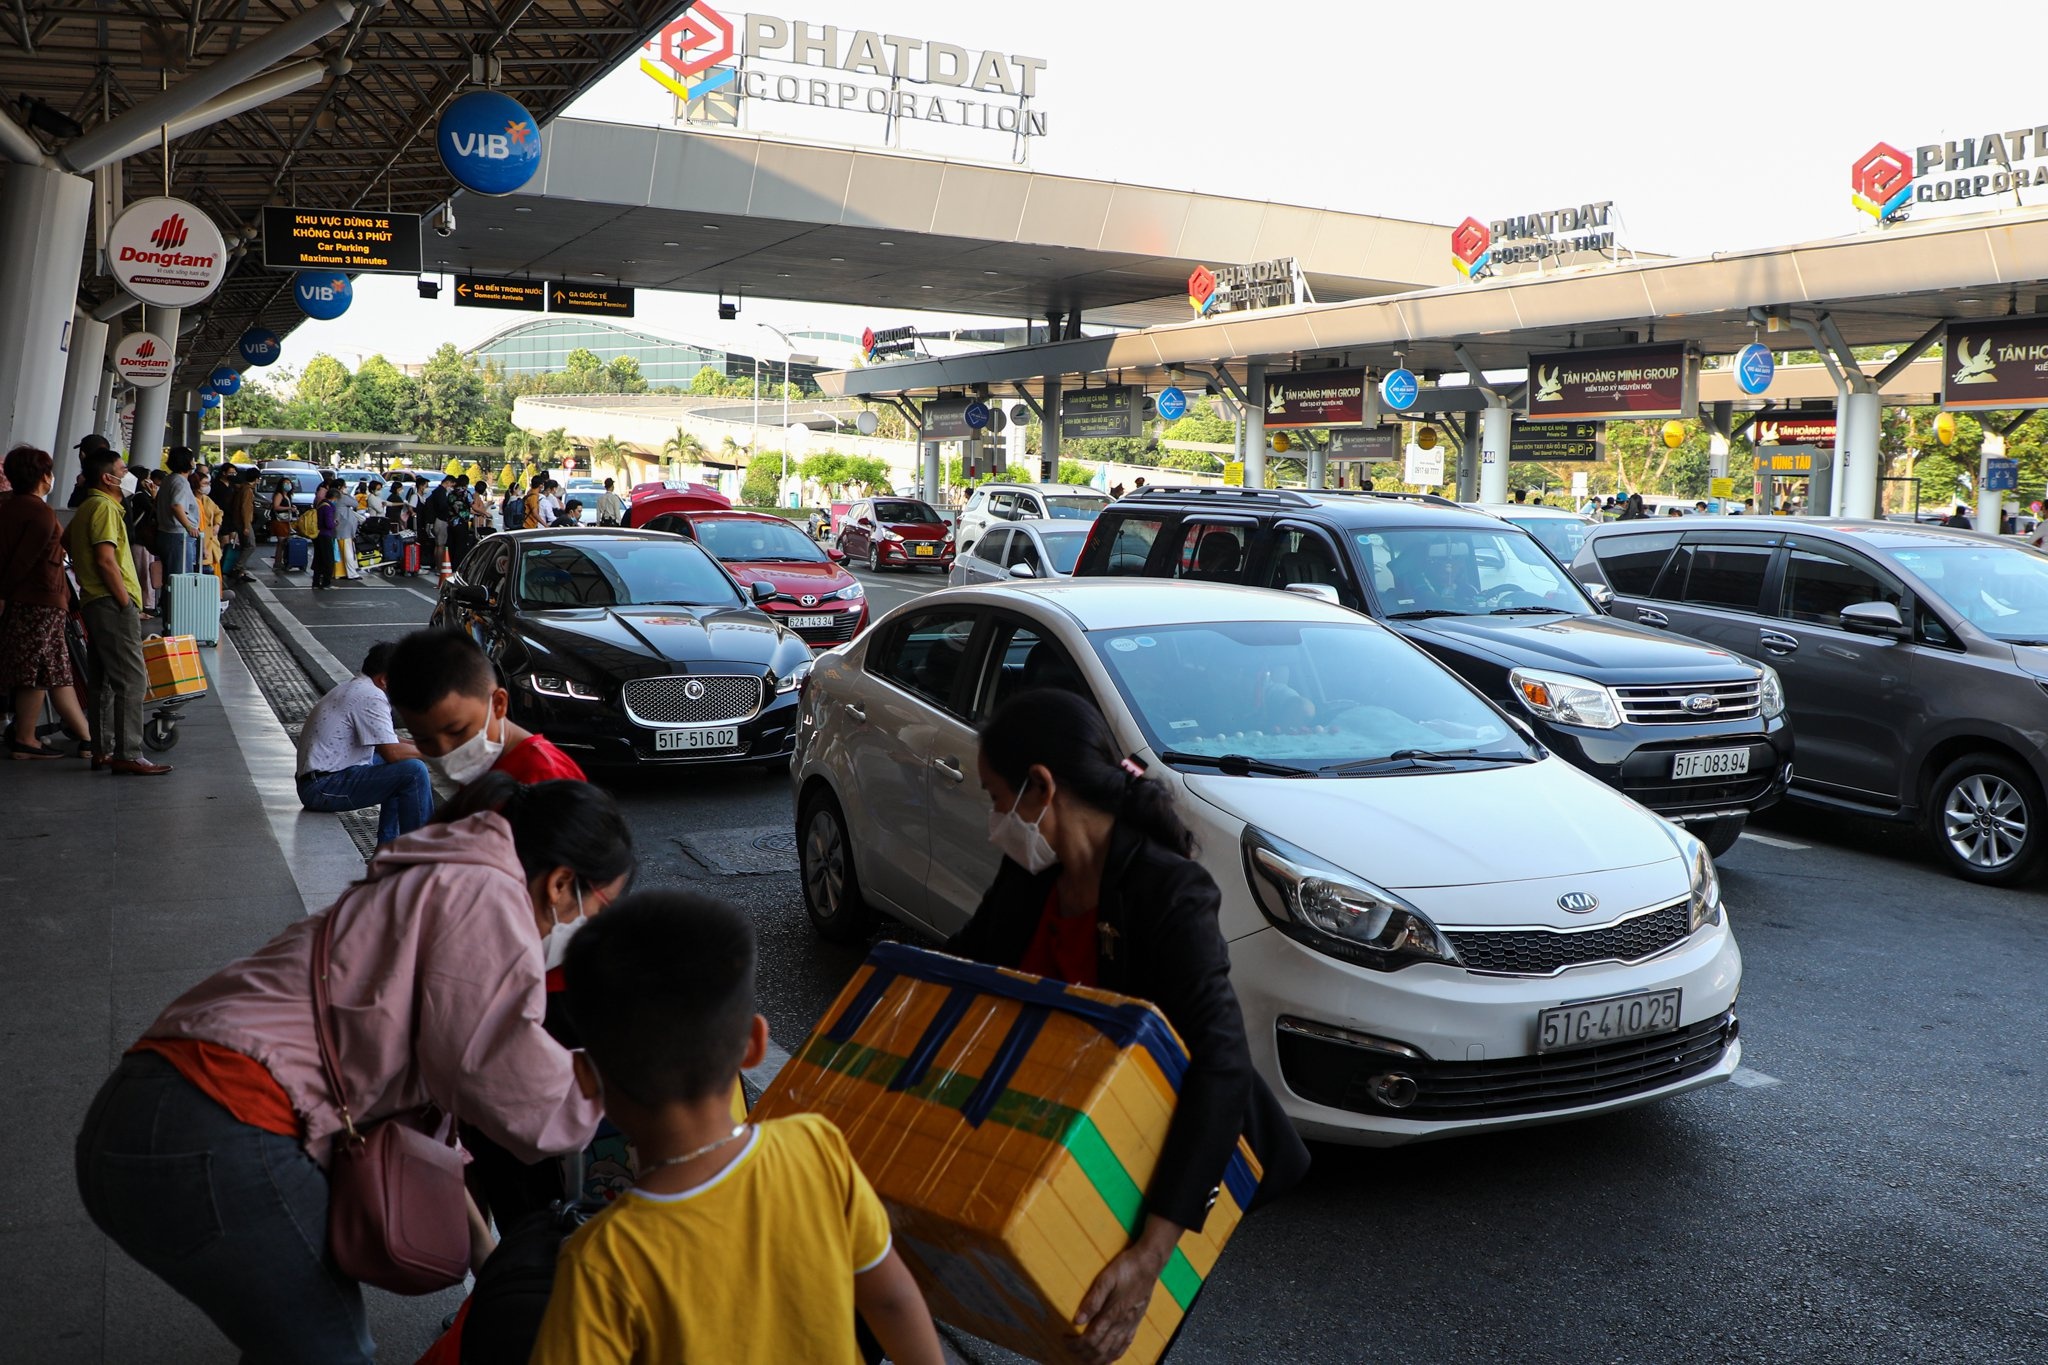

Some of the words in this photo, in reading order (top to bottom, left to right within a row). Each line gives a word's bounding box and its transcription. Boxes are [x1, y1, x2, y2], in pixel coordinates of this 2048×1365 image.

[744, 12, 1047, 97] PHATDAT
[744, 69, 1047, 136] CORPORATION
[451, 131, 510, 159] VIB
[296, 215, 318, 224] KHU
[320, 216, 341, 228] VỰC
[344, 216, 373, 228] DỪNG
[375, 220, 389, 229] XE
[1490, 200, 1613, 243] PHATDAT
[293, 228, 330, 238] KHÔNG
[333, 230, 355, 240] QUÁ
[357, 232, 363, 240] 3
[366, 231, 392, 242] PHÚT
[318, 242, 333, 250] Car
[336, 243, 370, 254] Parking
[1491, 232, 1614, 263] CORPORATION
[120, 246, 213, 268] Dongtam
[300, 254, 343, 264] Maximum
[345, 256, 351, 264] 3
[353, 256, 388, 266] Minutes
[1214, 256, 1293, 288] PHATDAT
[134, 276, 205, 287] www.dongtam.com.vn
[300, 286, 334, 300] VIB
[474, 292, 500, 300] Domestic
[486, 284, 499, 292] ĐẾN
[500, 286, 524, 294] TRONG
[1214, 281, 1293, 303] CORPORATION
[245, 343, 268, 354] VIB
[1997, 343, 2026, 362] TÂN
[120, 357, 168, 368] Dongtam
[214, 378, 231, 386] VIB
[1562, 370, 1580, 385] TÂN
[1582, 368, 1616, 383] HOÀNG
[1618, 370, 1642, 381] MINH
[1644, 368, 1679, 380] GROUP
[1286, 388, 1297, 400] TÂN
[1298, 388, 1320, 400] HOÀNG
[1321, 390, 1338, 398] MINH
[1338, 388, 1360, 398] GROUP
[1780, 425, 1793, 436] TÂN
[1794, 424, 1820, 436] HOÀNG
[1772, 453, 1793, 470] VŨNG
[1794, 452, 1812, 470] TÀU
[1692, 698, 1712, 709] Ford
[659, 730, 734, 748] 51F-516.02
[1676, 752, 1746, 776] 51F-083.94
[1564, 894, 1595, 908] KIA
[1544, 994, 1675, 1046] 51G-410.25
